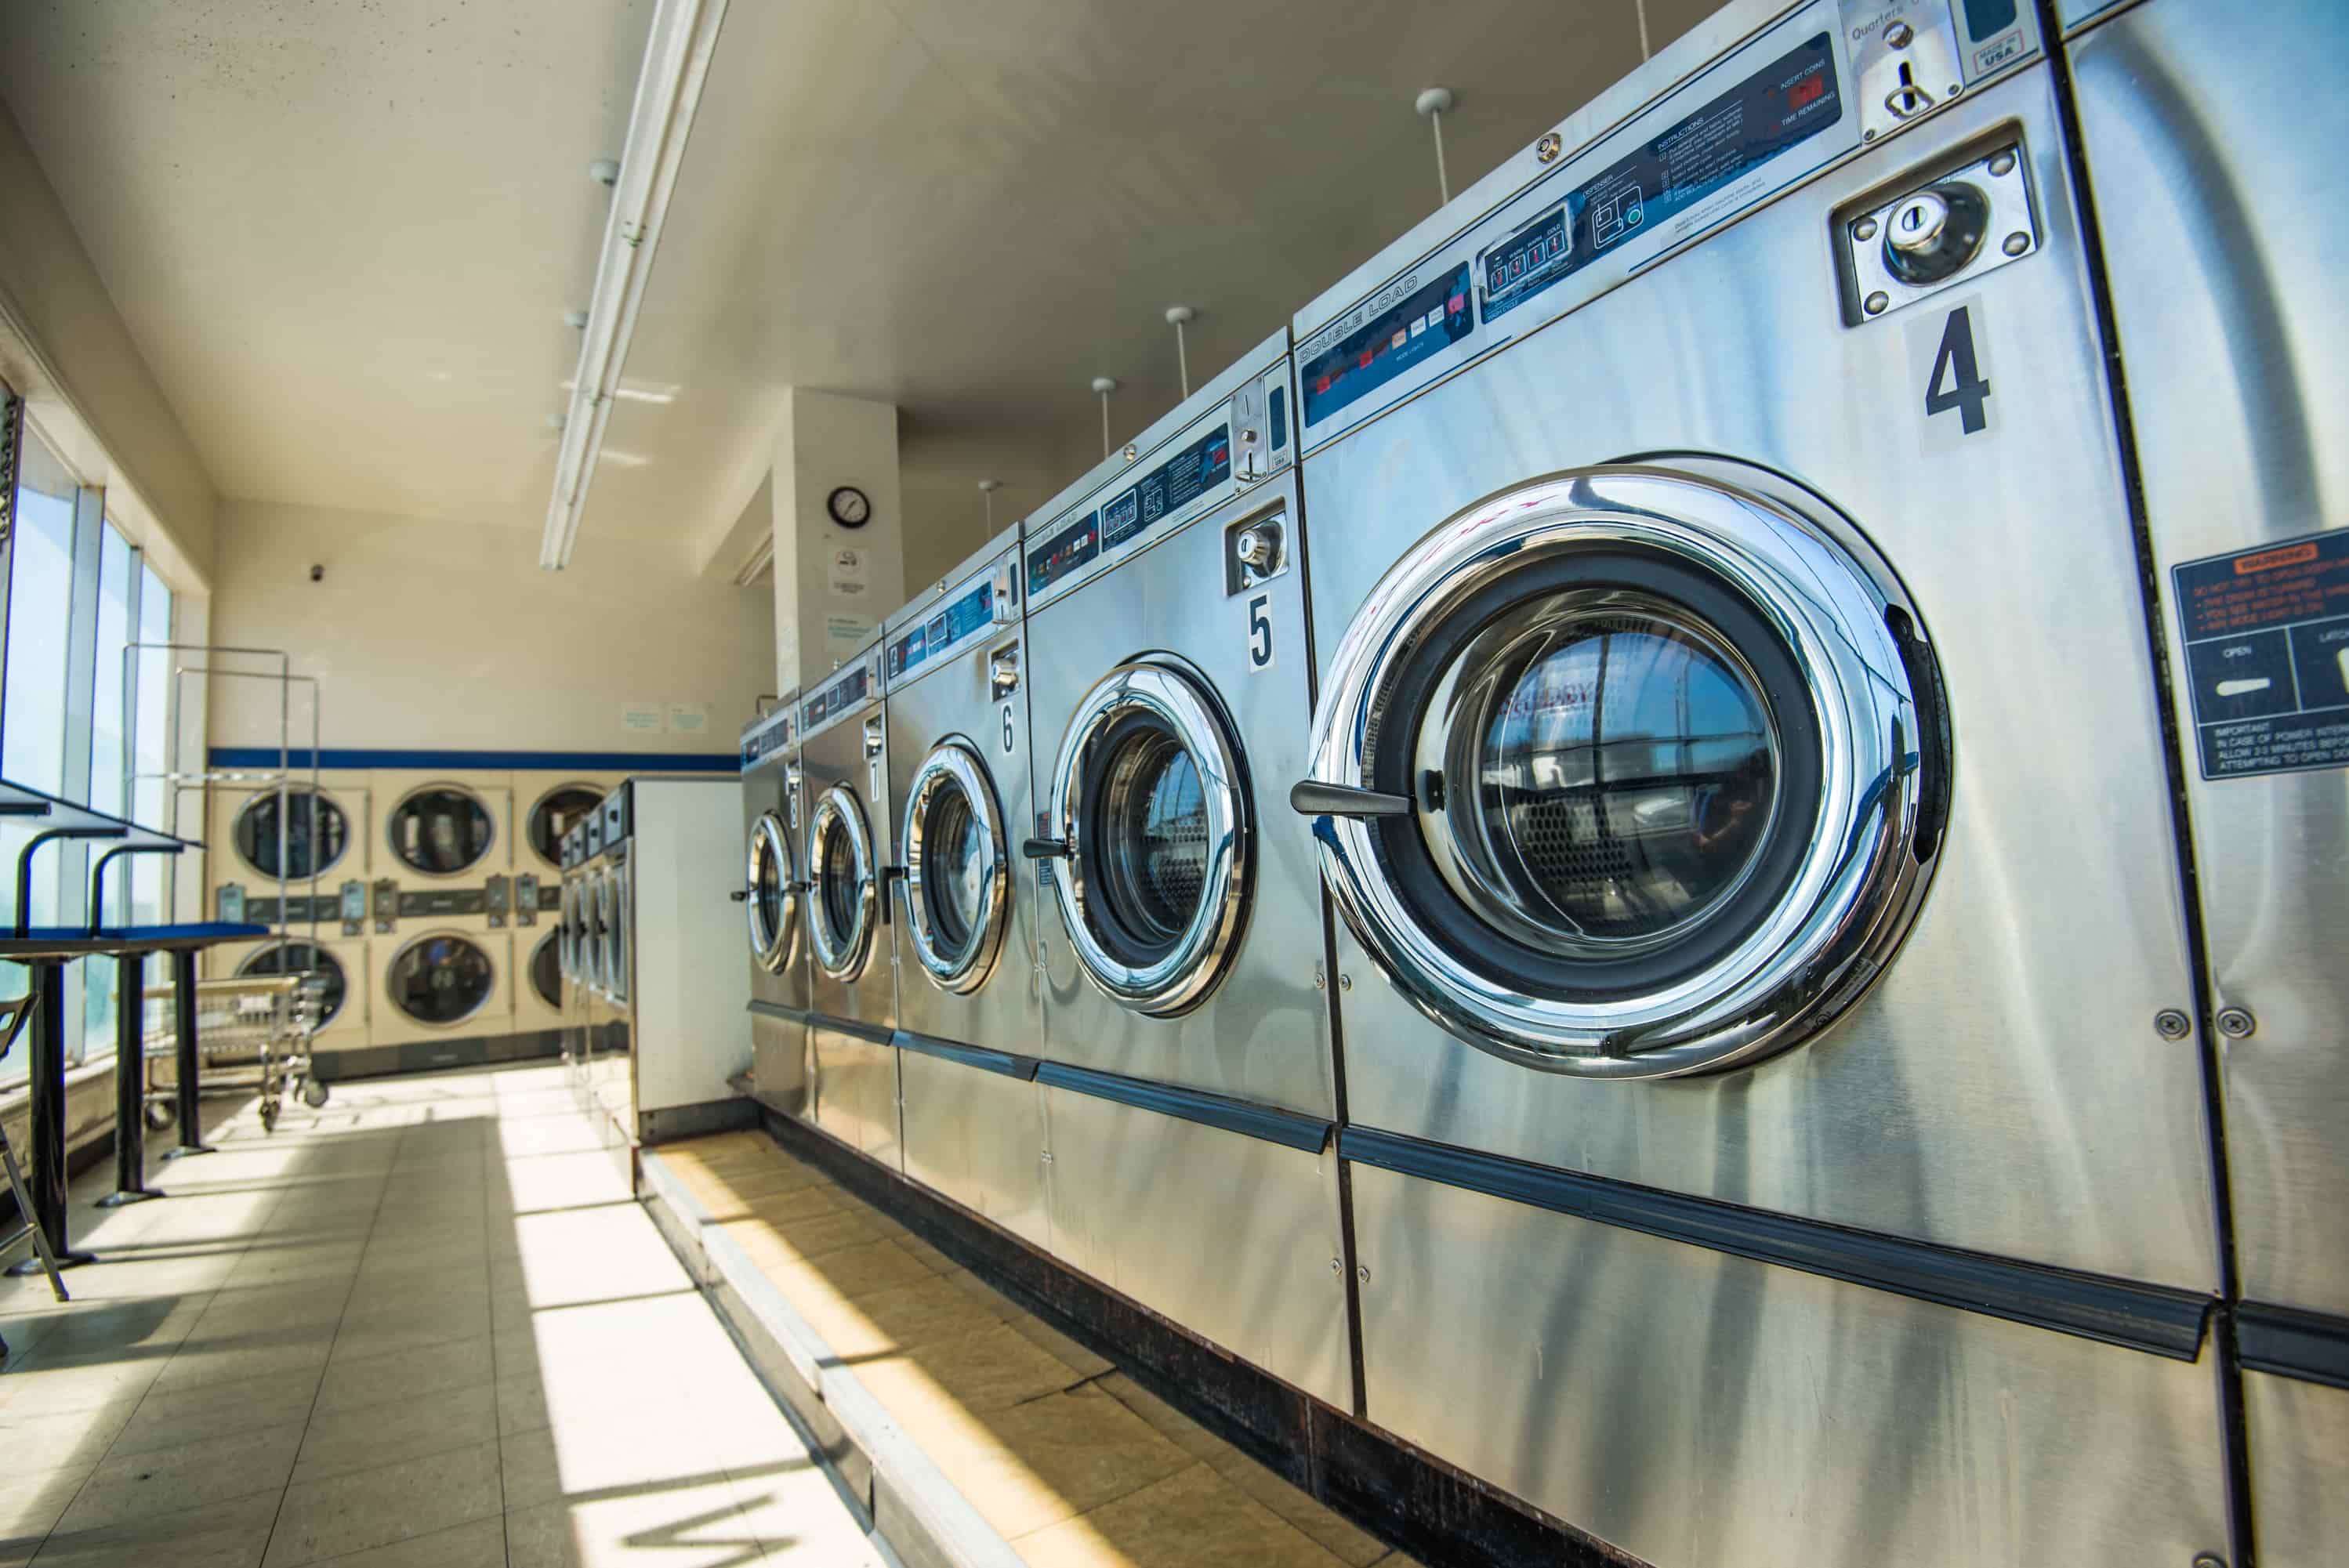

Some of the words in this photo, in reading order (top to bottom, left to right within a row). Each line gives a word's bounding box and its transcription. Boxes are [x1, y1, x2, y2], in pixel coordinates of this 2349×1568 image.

[1852, 6, 1904, 40] Quarters
[1985, 46, 2014, 66] USA
[1780, 71, 1803, 90] INSERT
[1804, 58, 1825, 76] COINS
[1780, 112, 1798, 126] TIME
[1798, 90, 1835, 115] REMAINING
[1657, 117, 1704, 150] INSTRUCTIONS
[1300, 311, 1363, 364] DOUBLE
[1368, 275, 1418, 316] LOAD
[1926, 306, 1991, 435] 4
[1250, 594, 1271, 666] 5
[2222, 646, 2252, 658] OPEN
[1003, 705, 1013, 753] 6
[2215, 721, 2270, 737] IMPORTANT
[2216, 739, 2228, 749] IN
[2228, 735, 2254, 747] CASE
[2257, 733, 2271, 744] OF
[2275, 727, 2314, 741] POWER
[2219, 747, 2253, 759] ALLOW
[2271, 740, 2318, 754] MINUTES
[2219, 754, 2282, 770] ATTEMPTING
[2300, 749, 2332, 762] OPEN
